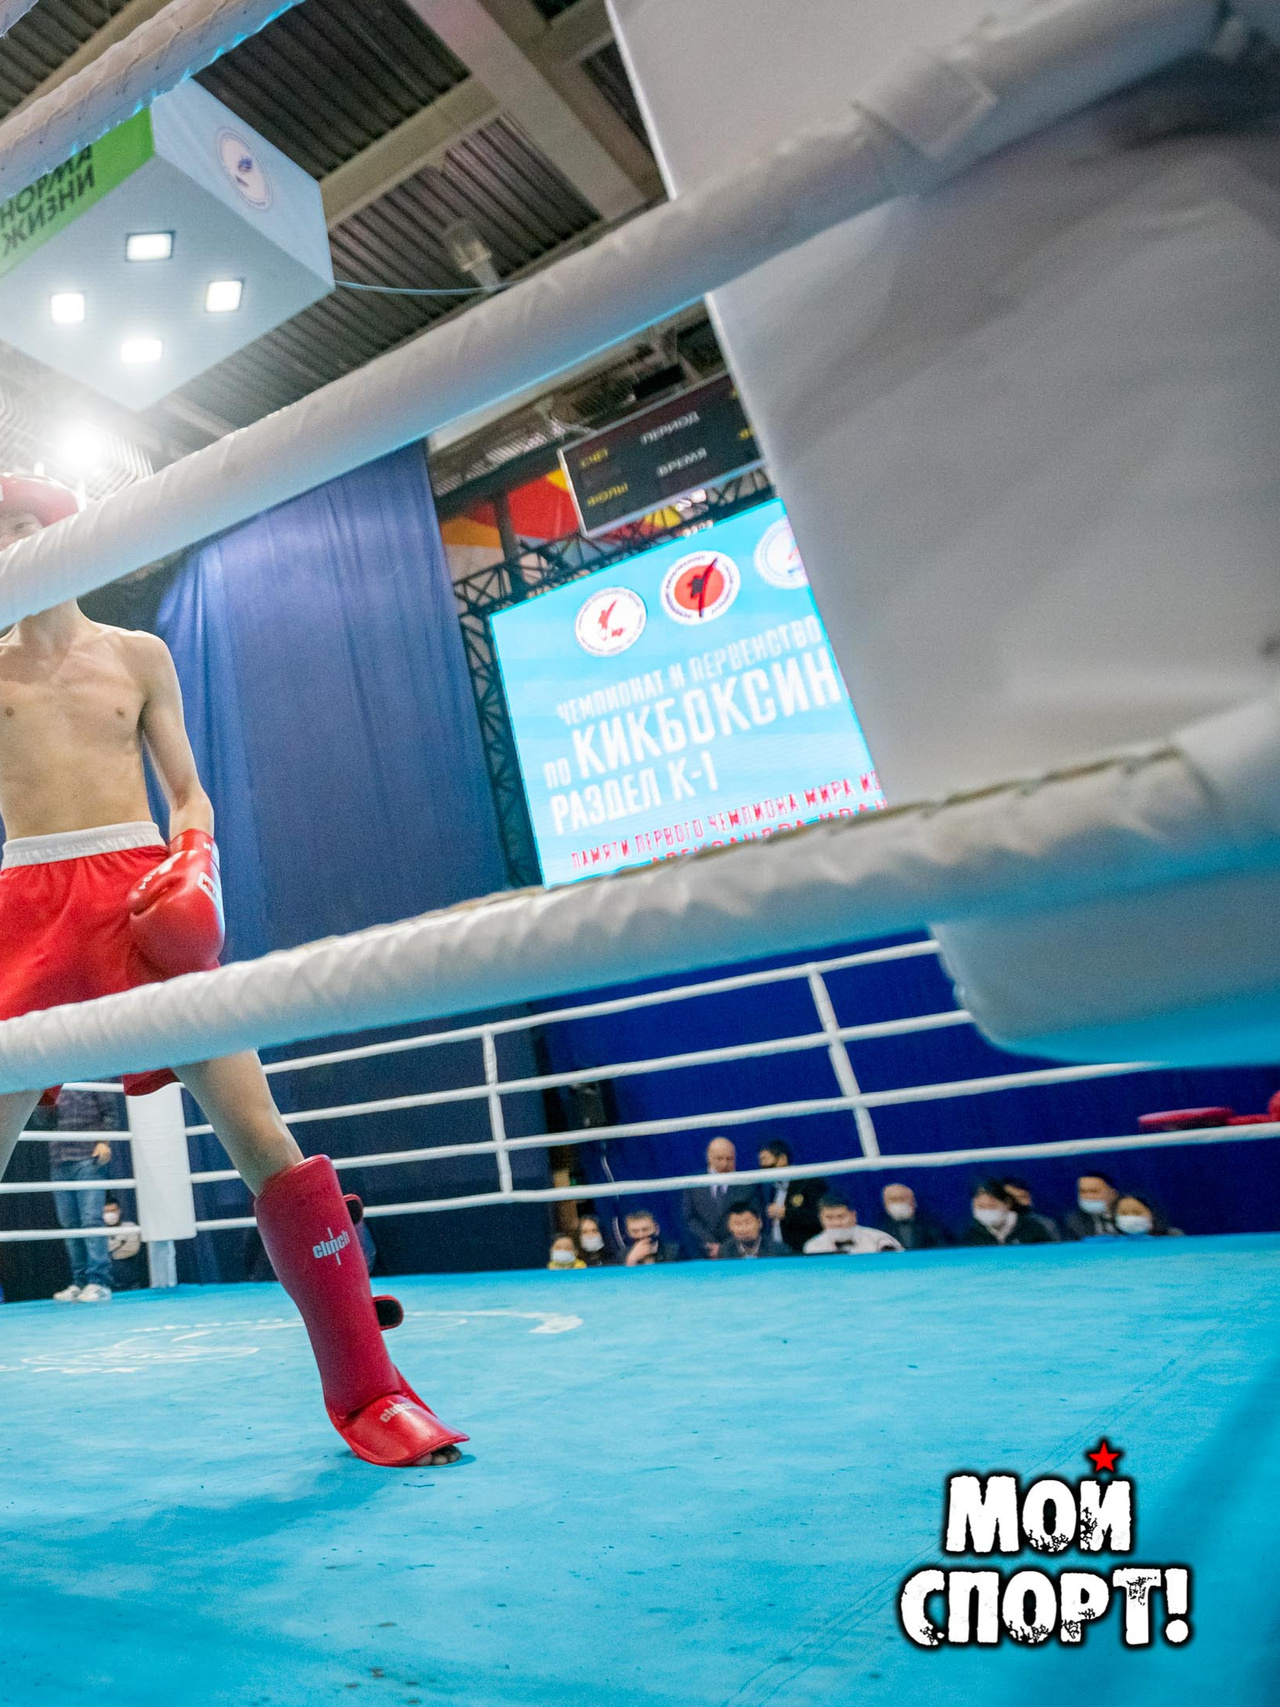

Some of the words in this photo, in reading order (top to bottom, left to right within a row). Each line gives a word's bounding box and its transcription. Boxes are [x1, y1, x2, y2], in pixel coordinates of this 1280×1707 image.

[0, 145, 93, 229] НОРМА
[1, 164, 96, 255] ЖИЗНИ
[639, 410, 701, 445] ПЕРИОД
[656, 447, 708, 478] ВРЕМЯ
[556, 669, 664, 726] ЧЕМПИОНАТ
[668, 662, 685, 689] И
[688, 614, 823, 683] ПЕРВЕНСТВО
[572, 647, 842, 780] КИКБОКСИН
[550, 767, 662, 836] РАЗДЕЛ
[571, 841, 631, 870] ПАМЯТИ
[634, 818, 705, 853] ПЕРВОГО
[708, 793, 799, 833] ЧЕМПИОНА
[804, 778, 856, 808] МИРА
[312, 1229, 351, 1259] clinch
